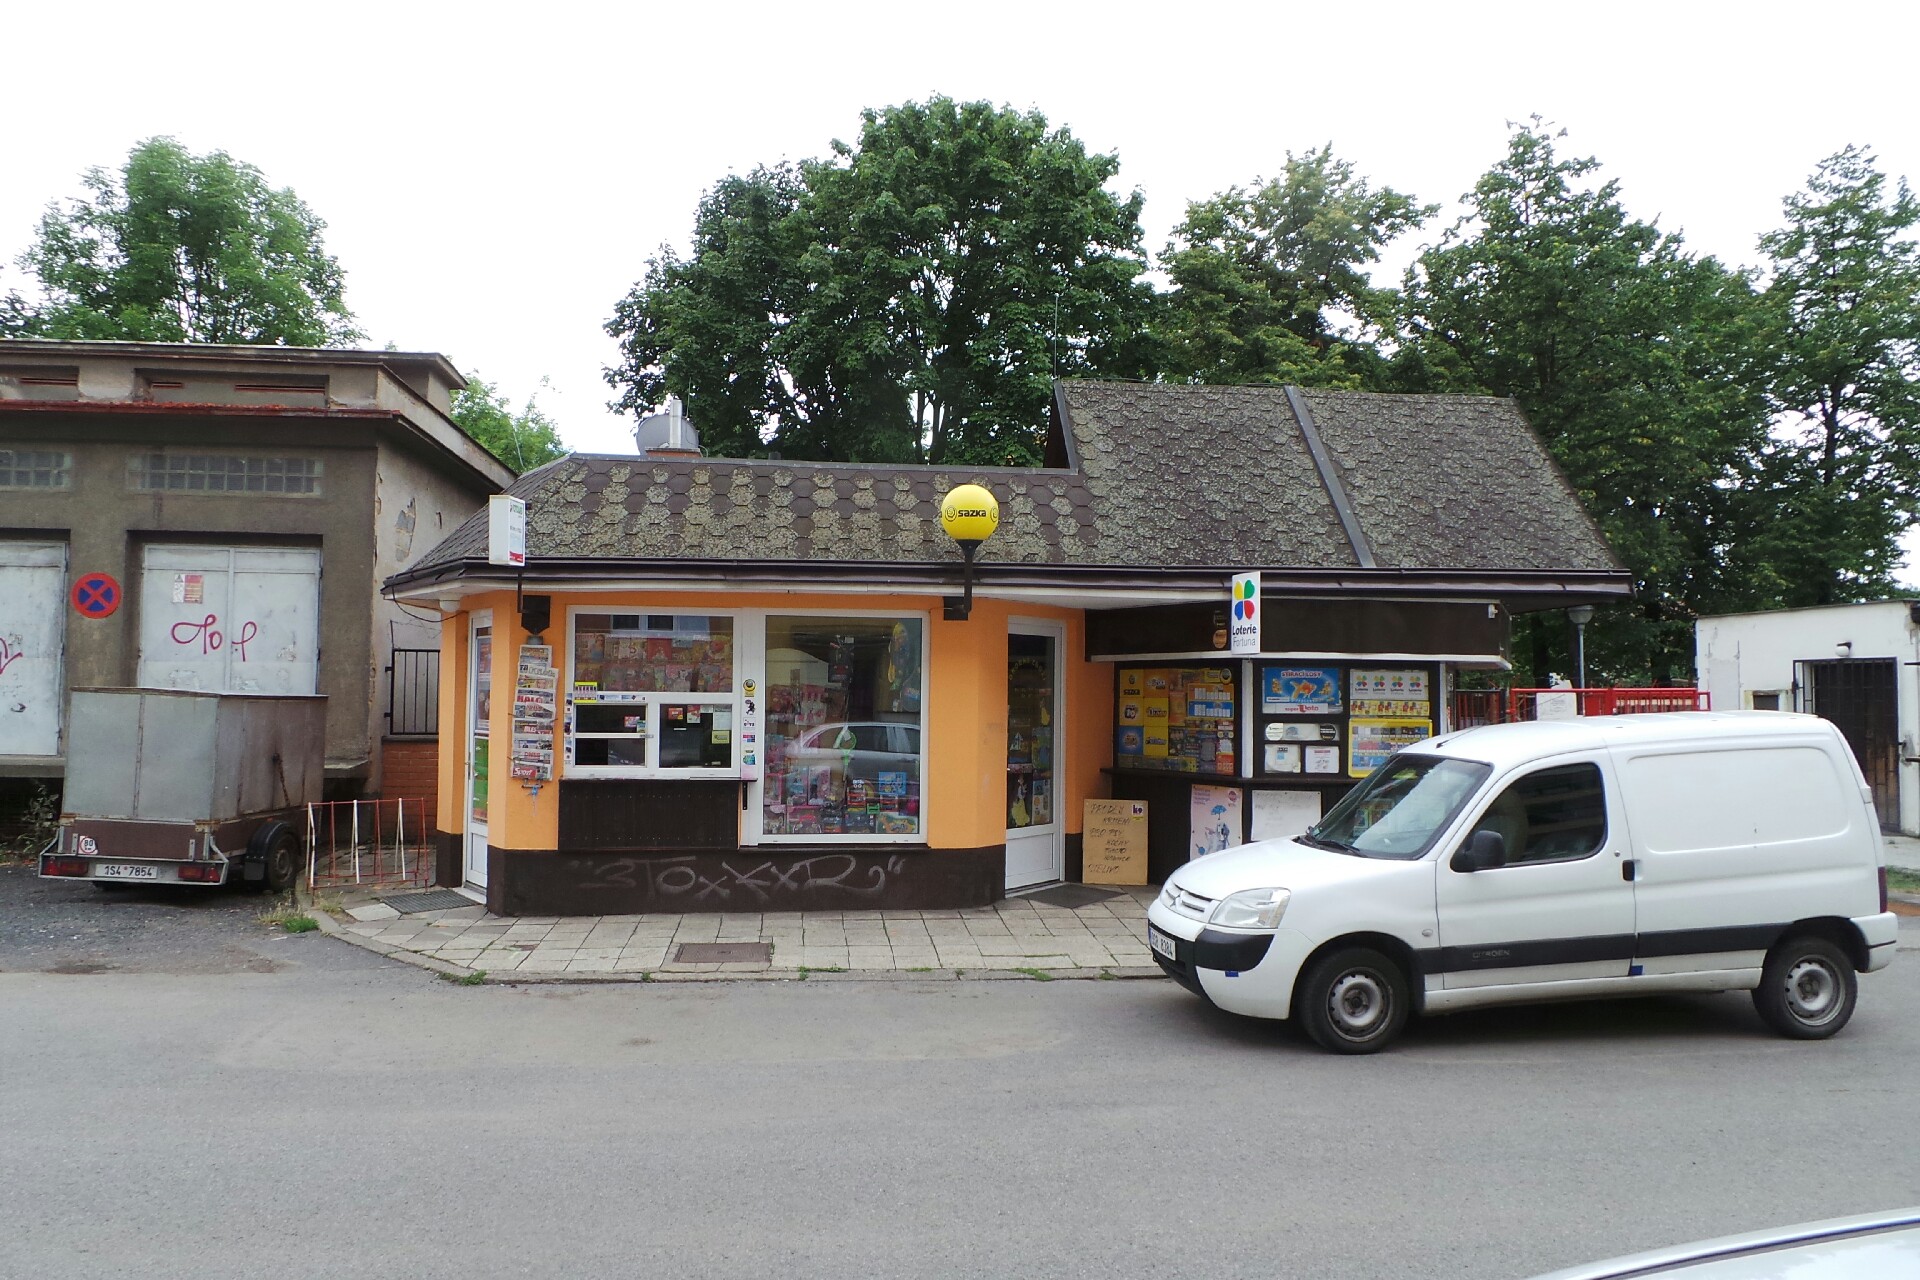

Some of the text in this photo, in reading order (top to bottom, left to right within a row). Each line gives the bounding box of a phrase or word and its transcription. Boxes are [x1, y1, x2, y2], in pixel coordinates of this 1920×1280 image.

[958, 509, 987, 518] sazka
[1232, 623, 1257, 636] Loterie
[1232, 636, 1256, 648] Fortuna
[513, 767, 531, 776] Sport
[104, 865, 153, 877] 1S4 7854
